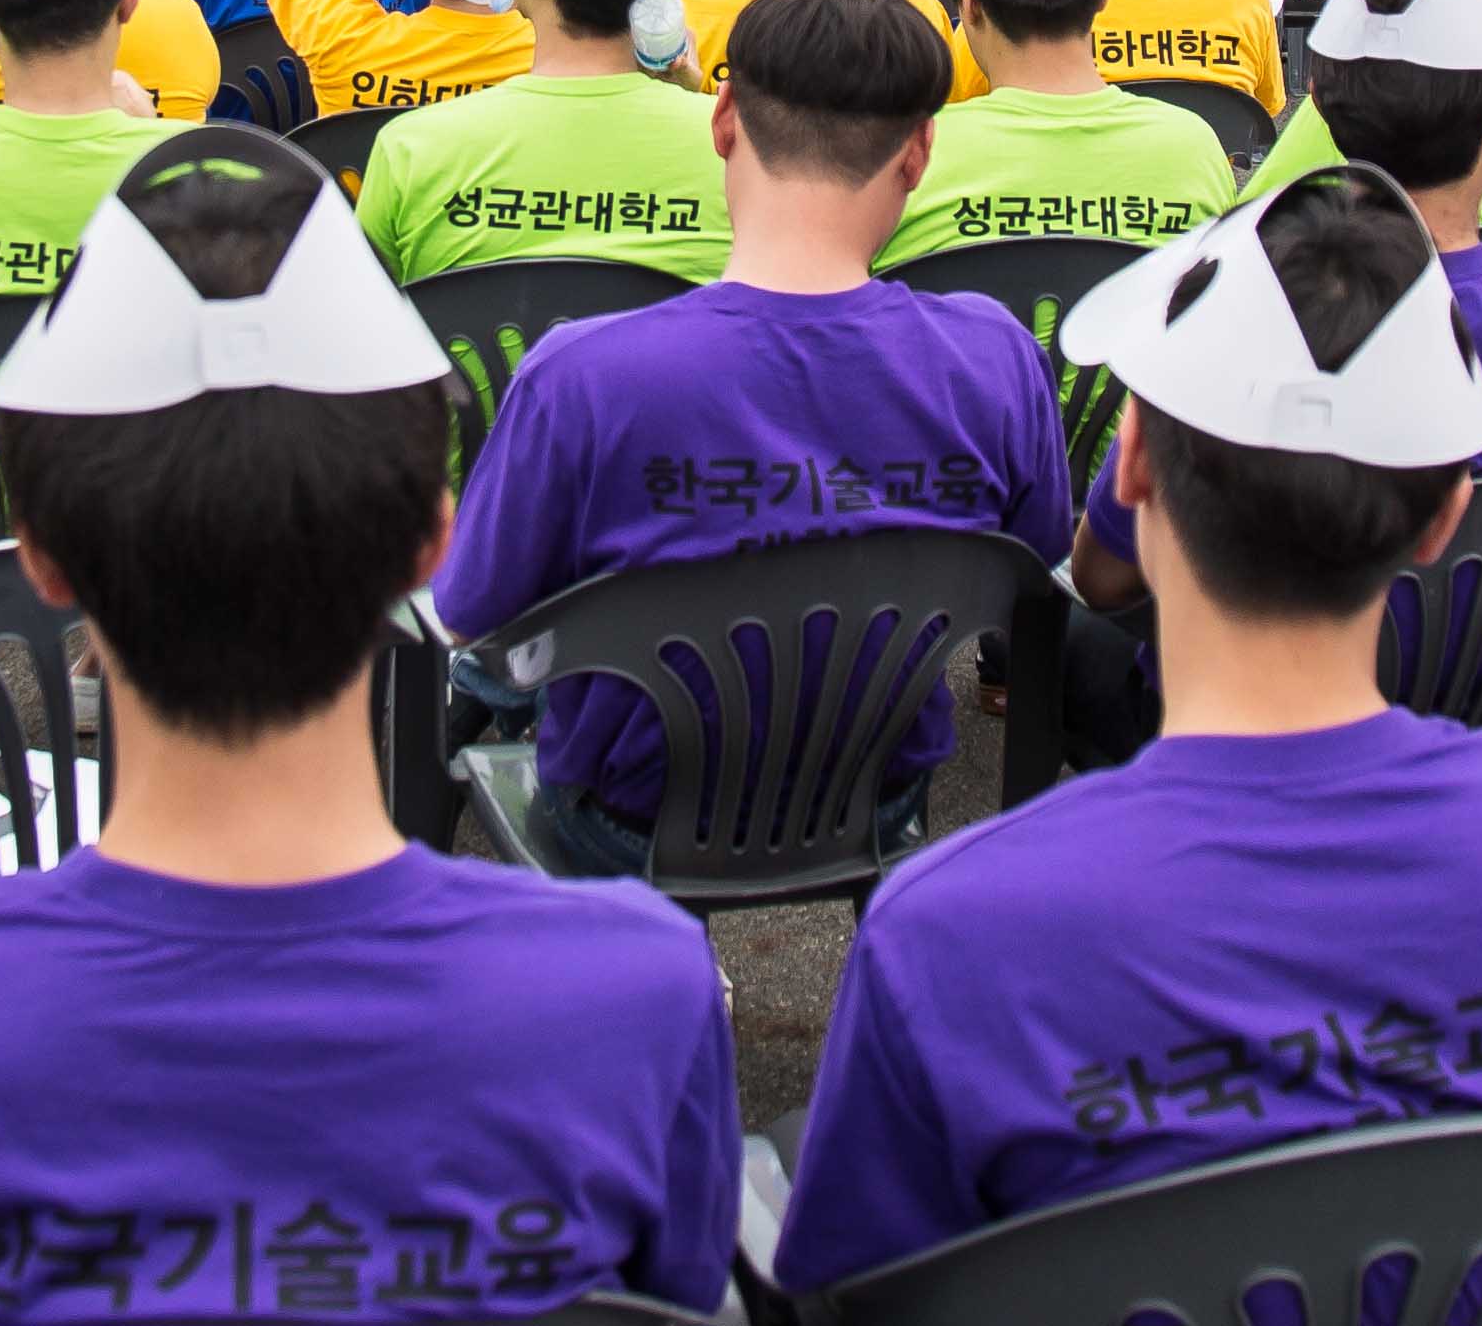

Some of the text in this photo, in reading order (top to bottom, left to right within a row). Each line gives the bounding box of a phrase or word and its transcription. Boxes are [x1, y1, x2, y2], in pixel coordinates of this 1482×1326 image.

[443, 187, 703, 235] 성균관대학교
[952, 194, 1194, 237] 성균관대학교
[642, 455, 985, 518] 한국기술교육
